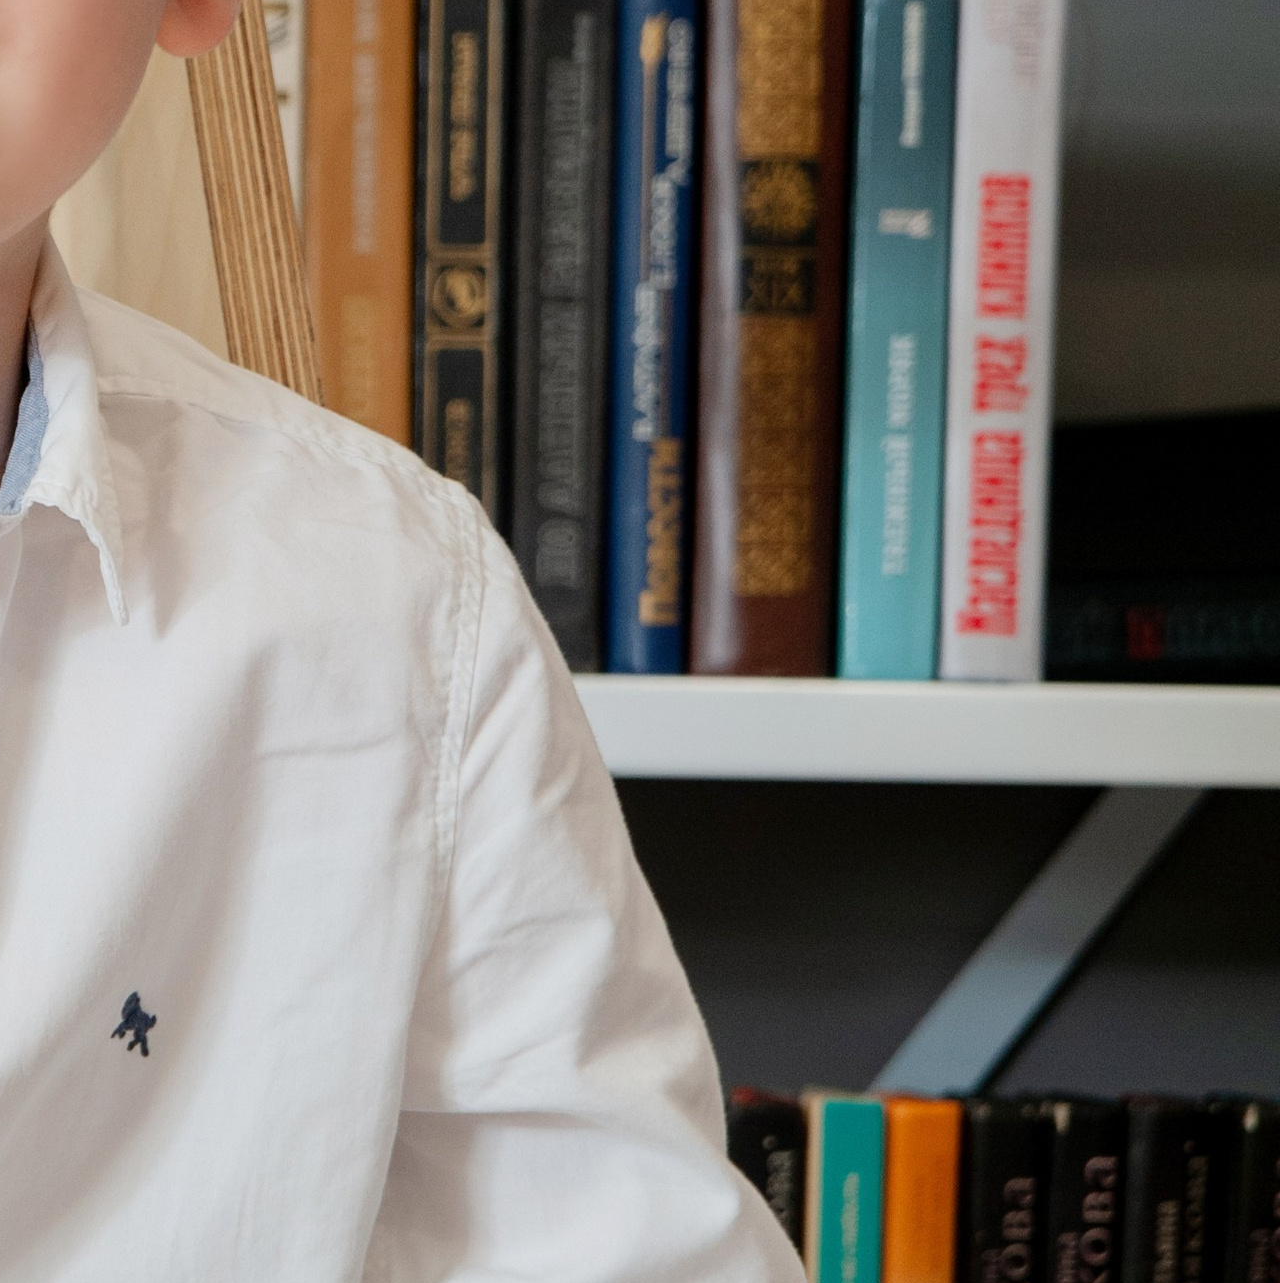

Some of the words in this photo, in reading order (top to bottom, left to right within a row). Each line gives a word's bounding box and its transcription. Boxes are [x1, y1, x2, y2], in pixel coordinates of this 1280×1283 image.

[974, 174, 1031, 321] клинков
[970, 334, 1029, 413] трех
[638, 439, 683, 627] Повести
[955, 429, 1024, 637] Наследница
